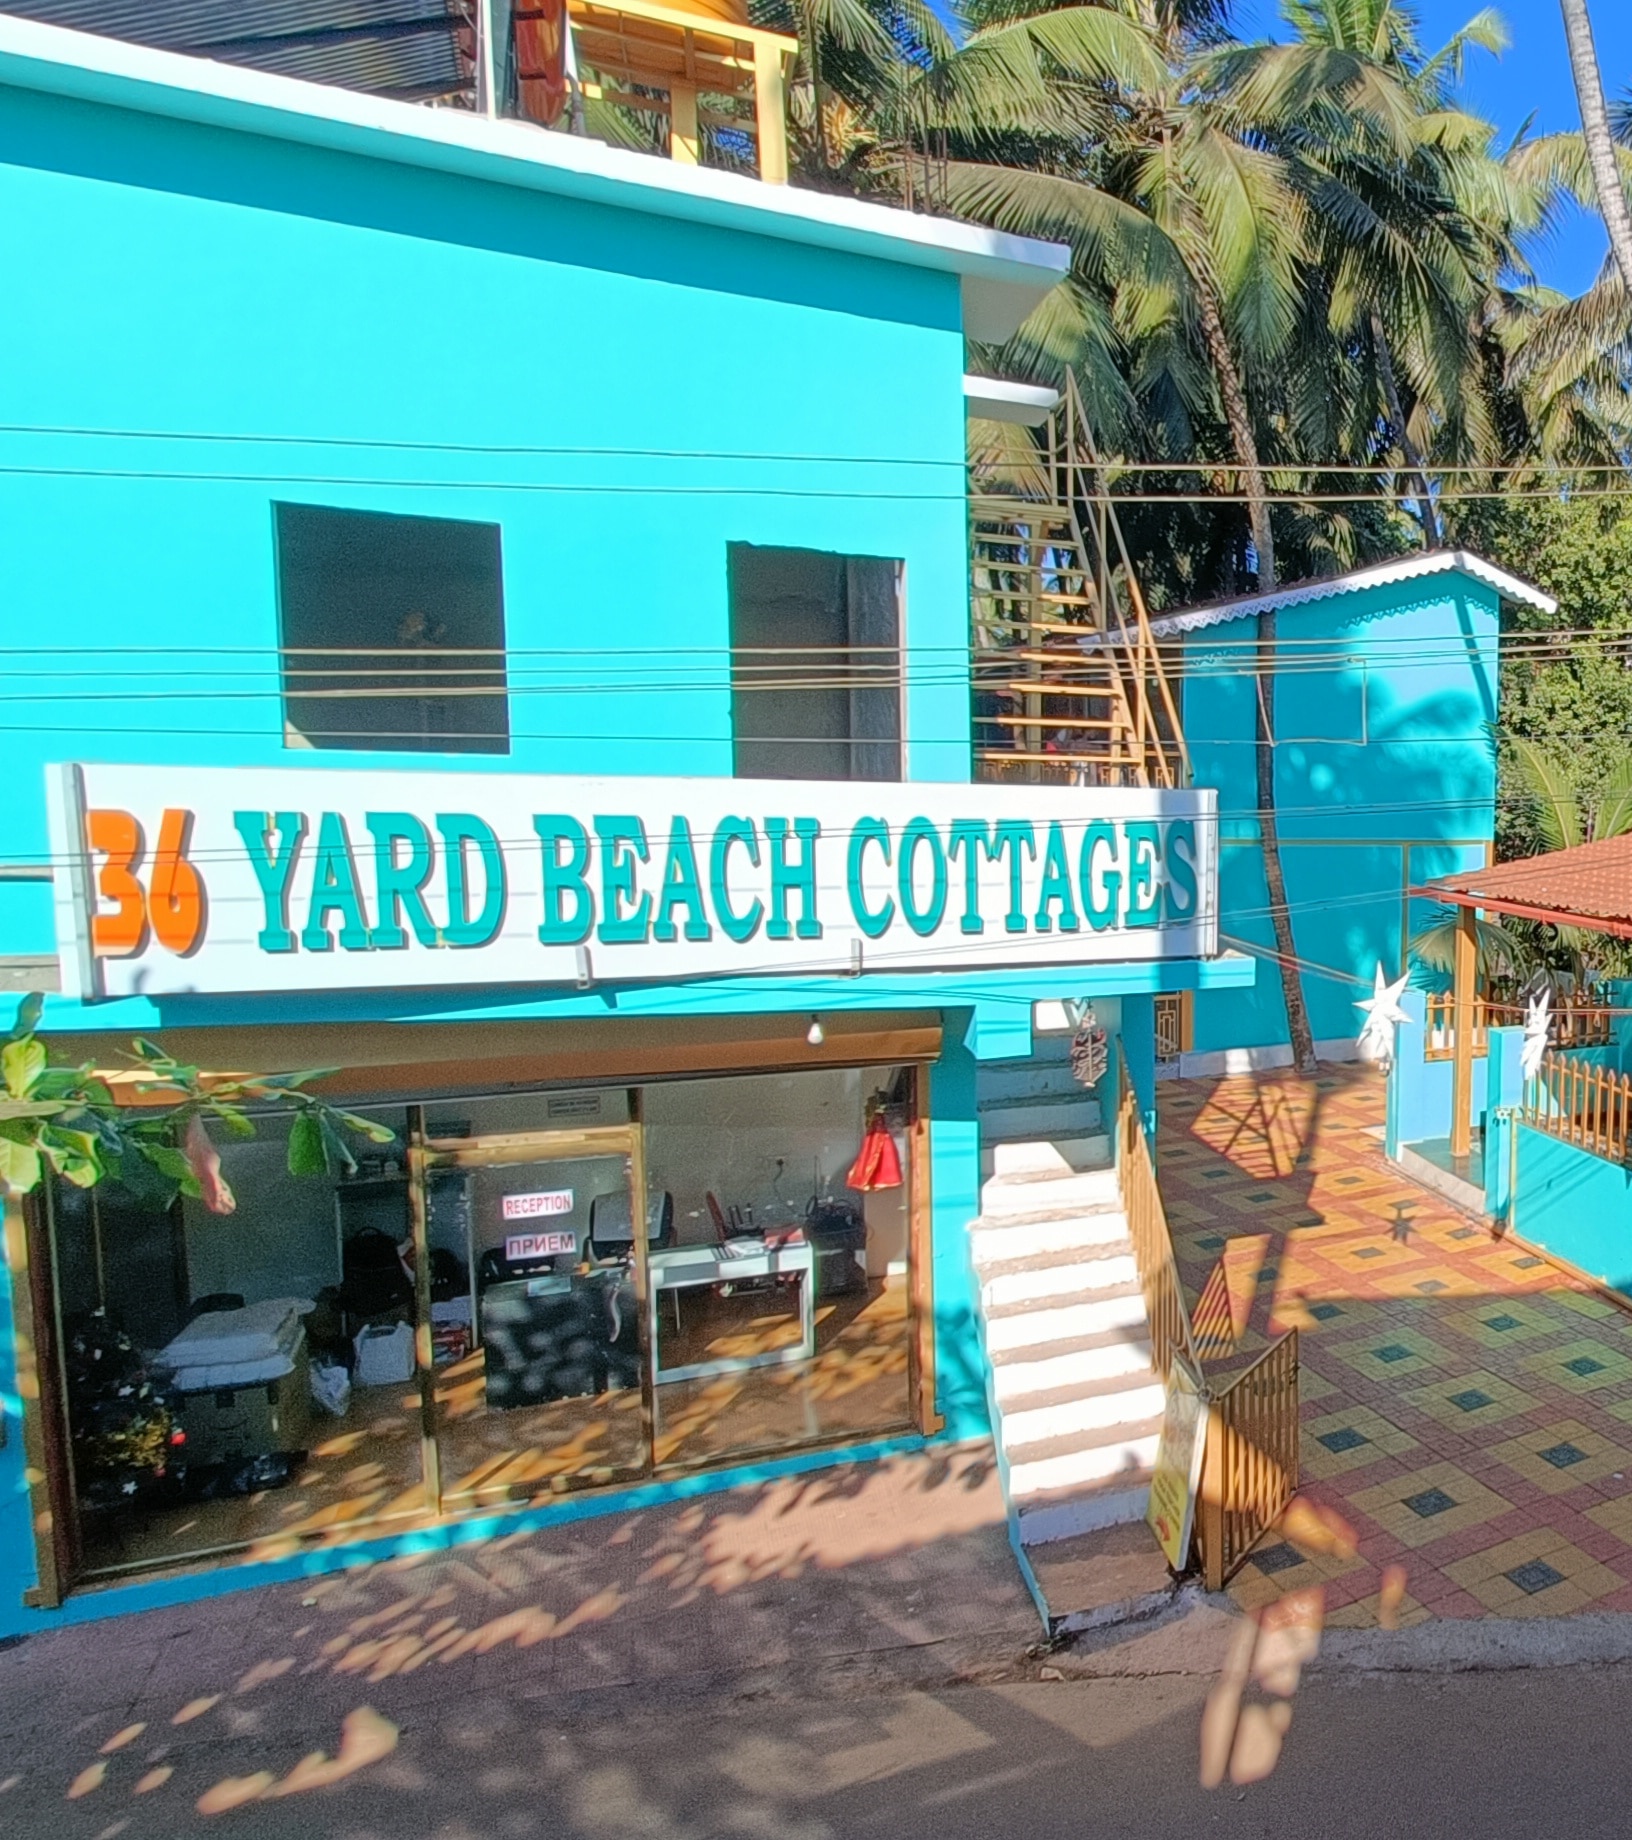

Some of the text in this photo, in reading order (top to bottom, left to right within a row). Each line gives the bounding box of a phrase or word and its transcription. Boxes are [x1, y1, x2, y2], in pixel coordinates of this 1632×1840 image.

[86, 808, 1197, 957] 36 YARD BEACH COTTAGES
[506, 1194, 571, 1216] RECEPTION
[509, 1233, 574, 1256] ПРИЕМ
